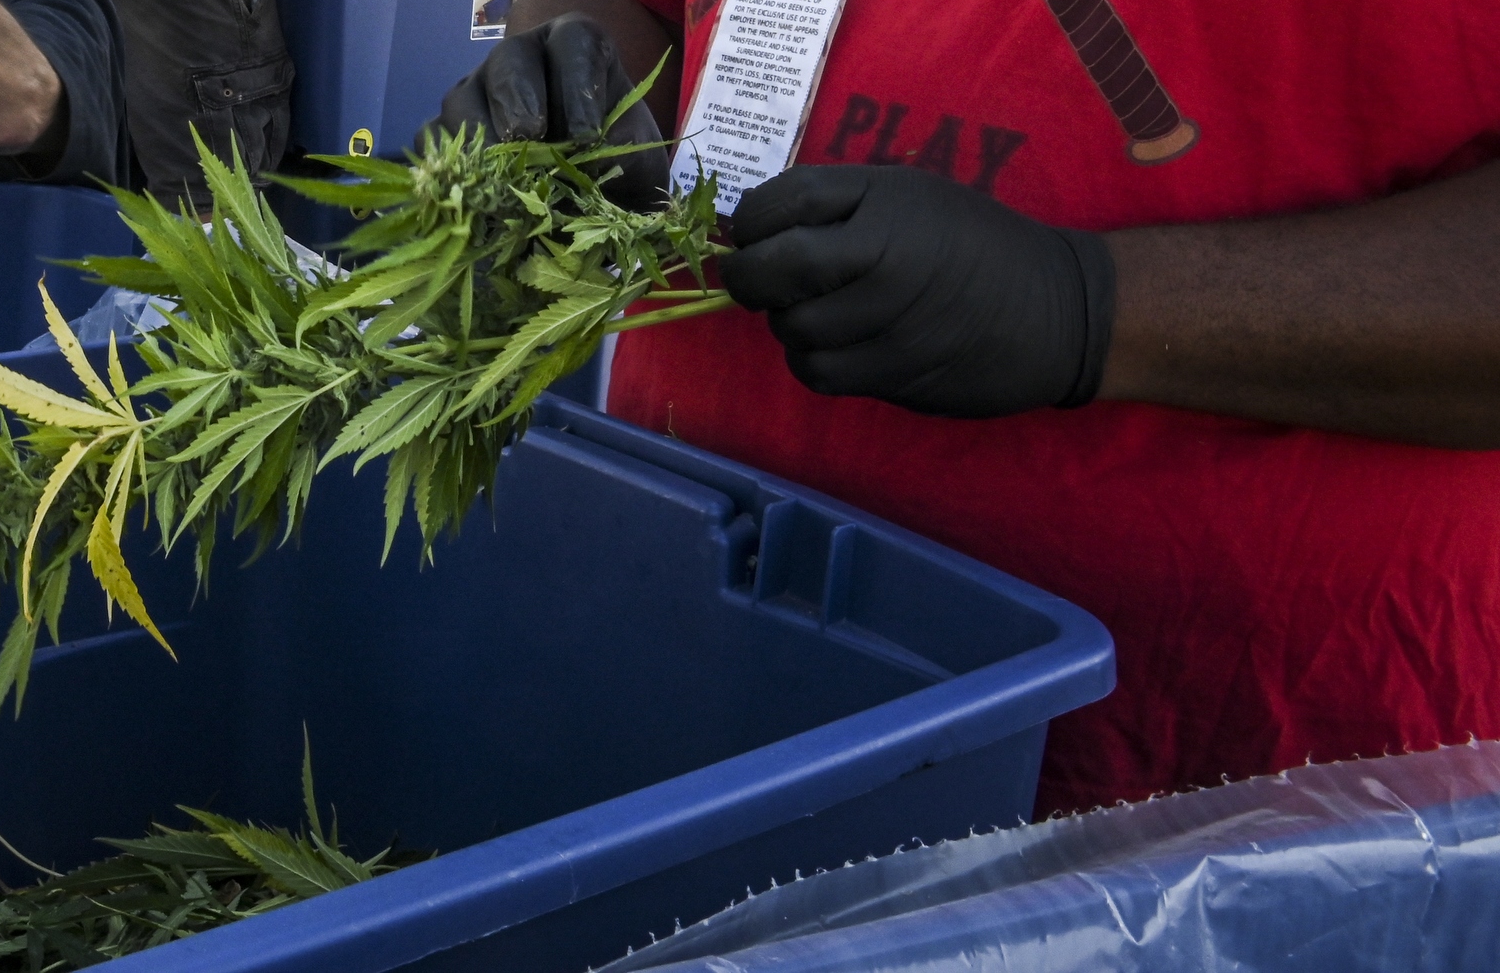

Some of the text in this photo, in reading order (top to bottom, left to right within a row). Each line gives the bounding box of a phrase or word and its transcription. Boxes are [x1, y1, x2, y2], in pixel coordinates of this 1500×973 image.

[757, 8, 785, 20] EXCLUSIVE
[809, 17, 820, 25] THE
[788, 4, 803, 12] BEEN
[804, 6, 826, 15] ISSUED
[729, 14, 819, 36] EMPLOYEE WHOSE NAME APPEARS
[748, 27, 757, 36] THE
[729, 35, 767, 47] TRANSFERABLE
[781, 44, 798, 54] SHALL
[721, 54, 754, 66] TERMINATION
[736, 47, 792, 63] SURRENDERED UPON
[715, 64, 734, 73] REPORT
[726, 76, 742, 86] THEFT
[742, 80, 769, 91] PROMPTLY
[780, 88, 795, 96] YOUR
[714, 104, 732, 113] FOUND
[732, 108, 752, 118] PLEASE
[753, 112, 768, 121] DROP
[776, 118, 788, 126] ANY
[716, 126, 750, 140] GUARANTEED
[738, 121, 759, 131] RETURN
[760, 126, 786, 137] POSTAGE
[826, 93, 1028, 193] PLAY
[707, 144, 723, 154] STATE
[732, 150, 760, 163] MARYLAND
[707, 168, 742, 183] COMISSION
[717, 160, 738, 172] MEDICAL
[740, 166, 767, 178] CANNABIS
[679, 172, 745, 194] 849 DRIV
